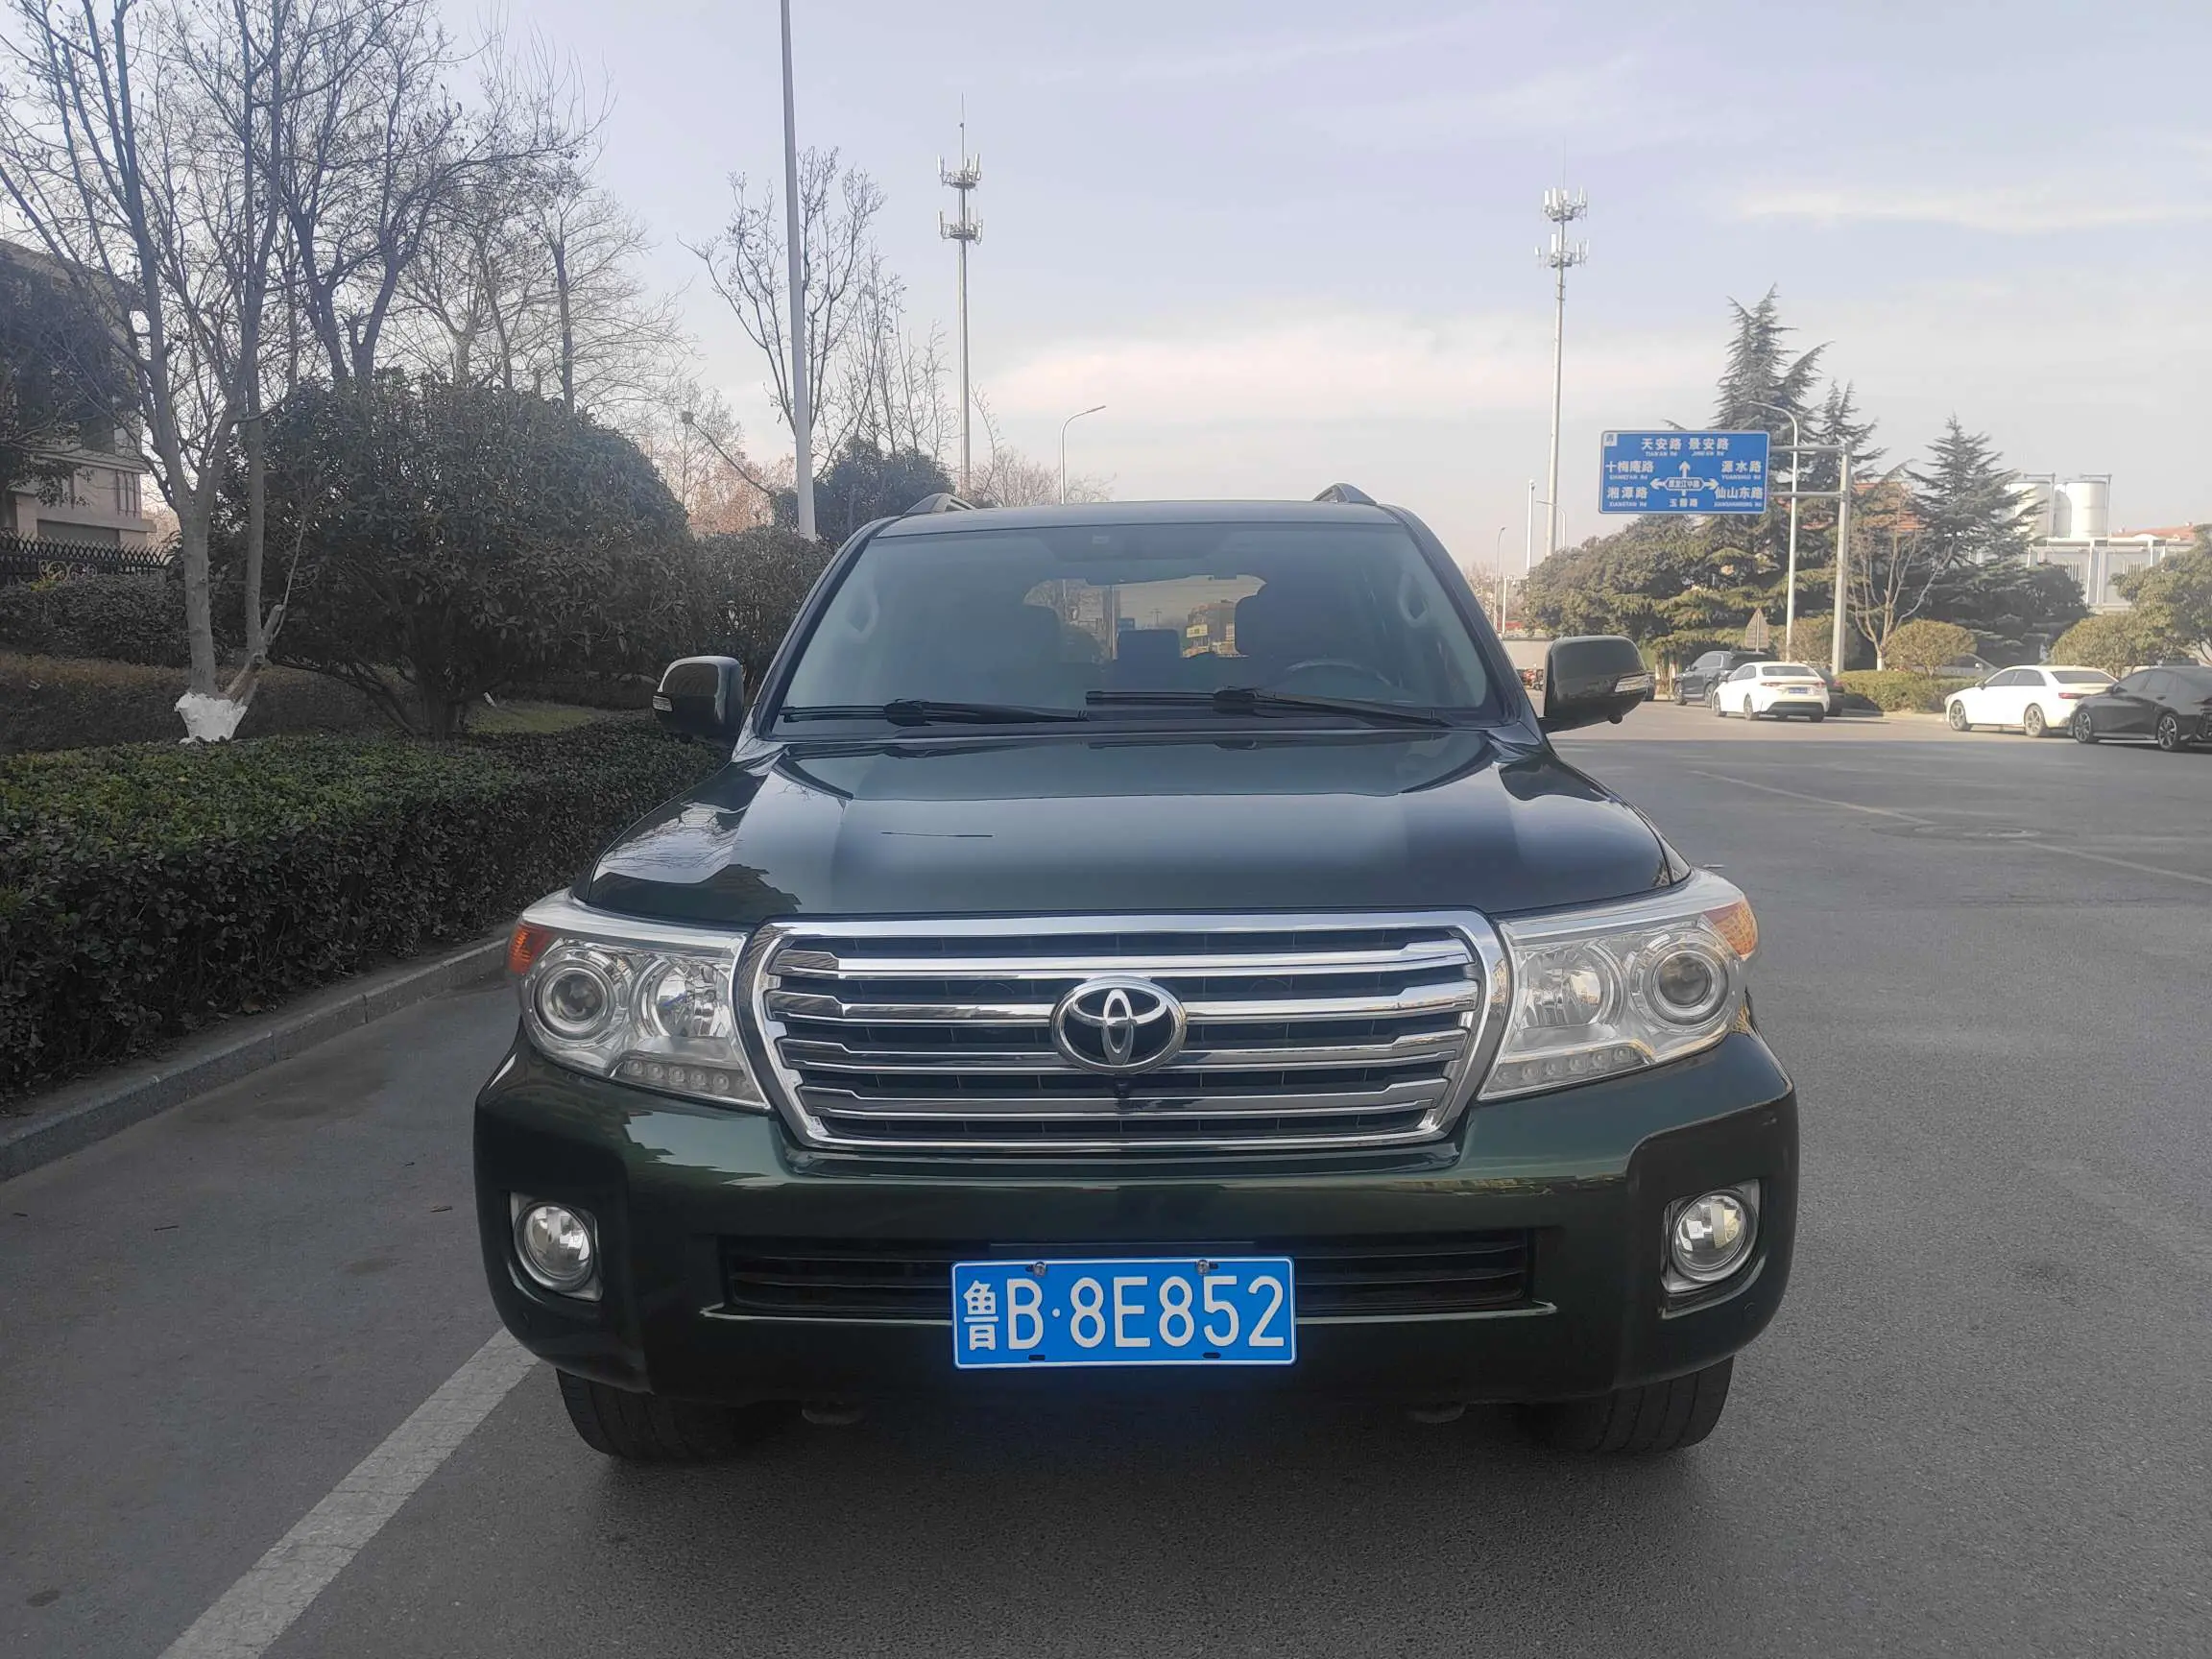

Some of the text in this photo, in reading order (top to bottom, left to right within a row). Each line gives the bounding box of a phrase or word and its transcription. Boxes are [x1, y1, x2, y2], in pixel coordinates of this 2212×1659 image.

[1642, 438, 1682, 450] 天安路
[1607, 487, 1647, 499] 湘潭路
[1715, 486, 1763, 499] 仙山东路
[962, 1275, 1286, 1351] 鲁B·8E852
